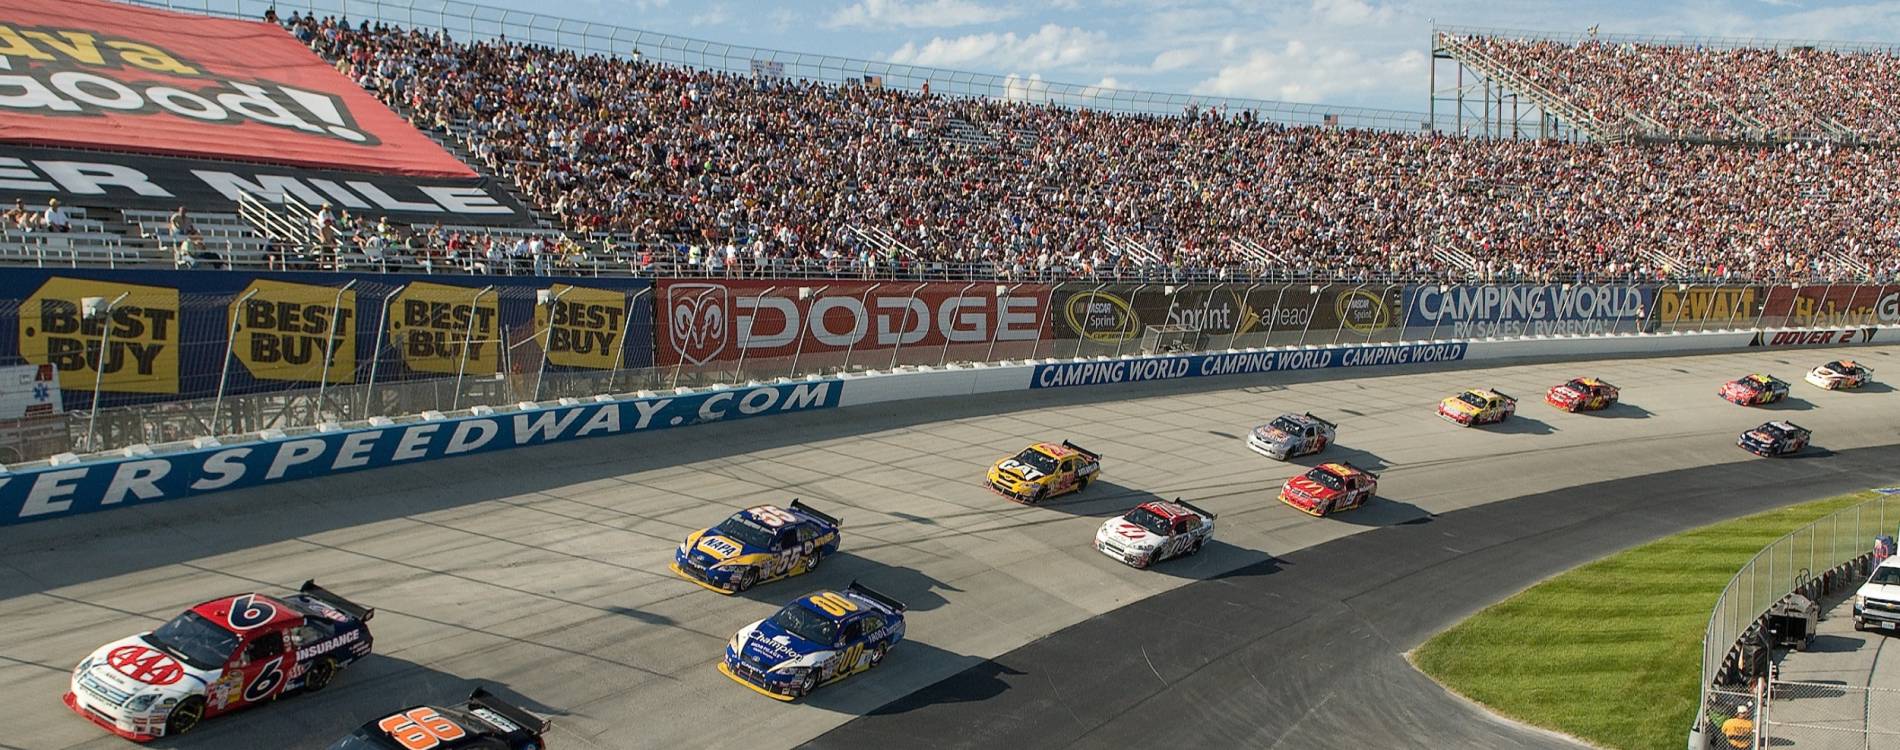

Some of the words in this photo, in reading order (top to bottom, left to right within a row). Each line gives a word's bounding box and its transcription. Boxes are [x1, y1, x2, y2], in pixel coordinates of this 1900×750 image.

[191, 170, 515, 214] MILE
[247, 300, 352, 336] BEST
[405, 300, 495, 333] BEST
[547, 302, 623, 333] BEST
[1168, 302, 1231, 331] Sprint
[1261, 303, 1310, 326] ahead
[1419, 287, 1546, 321] CAMPING
[1550, 286, 1642, 317] WORLD
[737, 296, 1038, 349] DODGE
[1090, 314, 1115, 329] Sprint
[1455, 320, 1473, 337] RV
[1475, 320, 1521, 337] SALES
[1535, 320, 1554, 337] RV
[251, 333, 345, 367] BUY
[408, 330, 488, 360] BUY
[552, 328, 616, 356] BUY
[1769, 330, 1835, 345] DOVER
[1838, 330, 1856, 344] 2
[48, 337, 164, 375] BUY
[1201, 353, 1278, 377] CAMPING
[1279, 350, 1332, 371] WORLD
[1342, 346, 1408, 367] CAMPING
[1411, 343, 1461, 363] WORLD
[1040, 361, 1125, 387] CAMPING
[1129, 358, 1189, 383] WORLD
[0, 381, 833, 519] ERSPEEDWAY.COM
[999, 460, 1044, 481] CAT
[703, 538, 737, 556] NAPA
[776, 546, 802, 574] 55
[227, 594, 276, 631] 6
[809, 592, 858, 617] 00
[296, 629, 360, 661] INSURANCE
[748, 629, 804, 664] Champion
[839, 641, 865, 672] 00
[107, 646, 184, 685] AAA
[244, 656, 283, 702] 6
